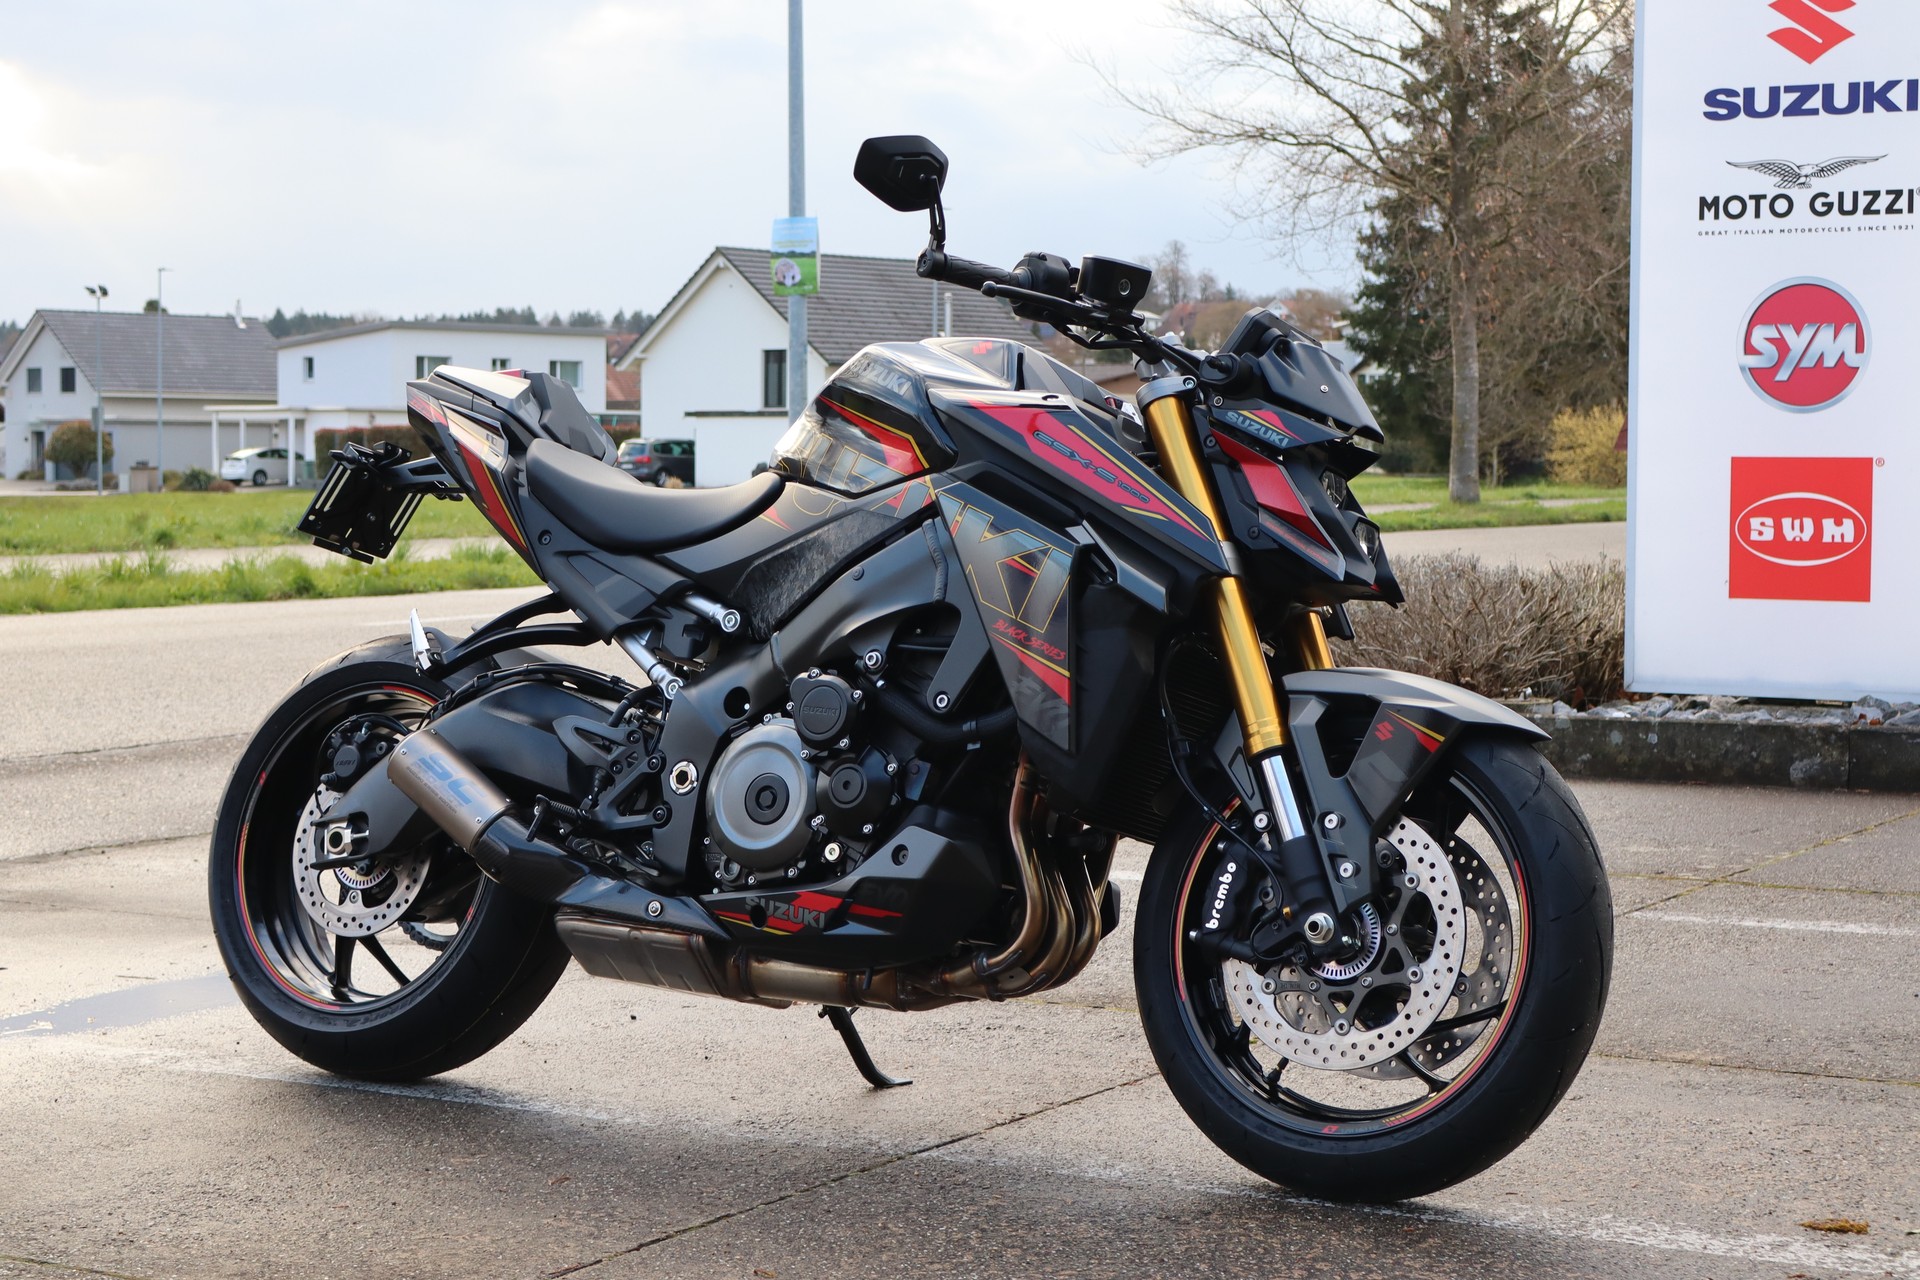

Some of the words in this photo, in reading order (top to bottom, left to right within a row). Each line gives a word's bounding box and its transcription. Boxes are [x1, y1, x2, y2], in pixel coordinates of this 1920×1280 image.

[1703, 79, 1919, 121] SUZUKI
[1698, 193, 1794, 221] MOTO
[1809, 189, 1914, 217] GUZZI
[1780, 226, 1852, 234] MOTORCYCLES
[1744, 323, 1862, 381] SYM
[1225, 411, 1290, 448] SUZUKI
[1750, 517, 1855, 543] SWM
[992, 619, 1028, 643] BLACK
[1023, 634, 1066, 660] SERIES
[1205, 861, 1237, 930] brembo
